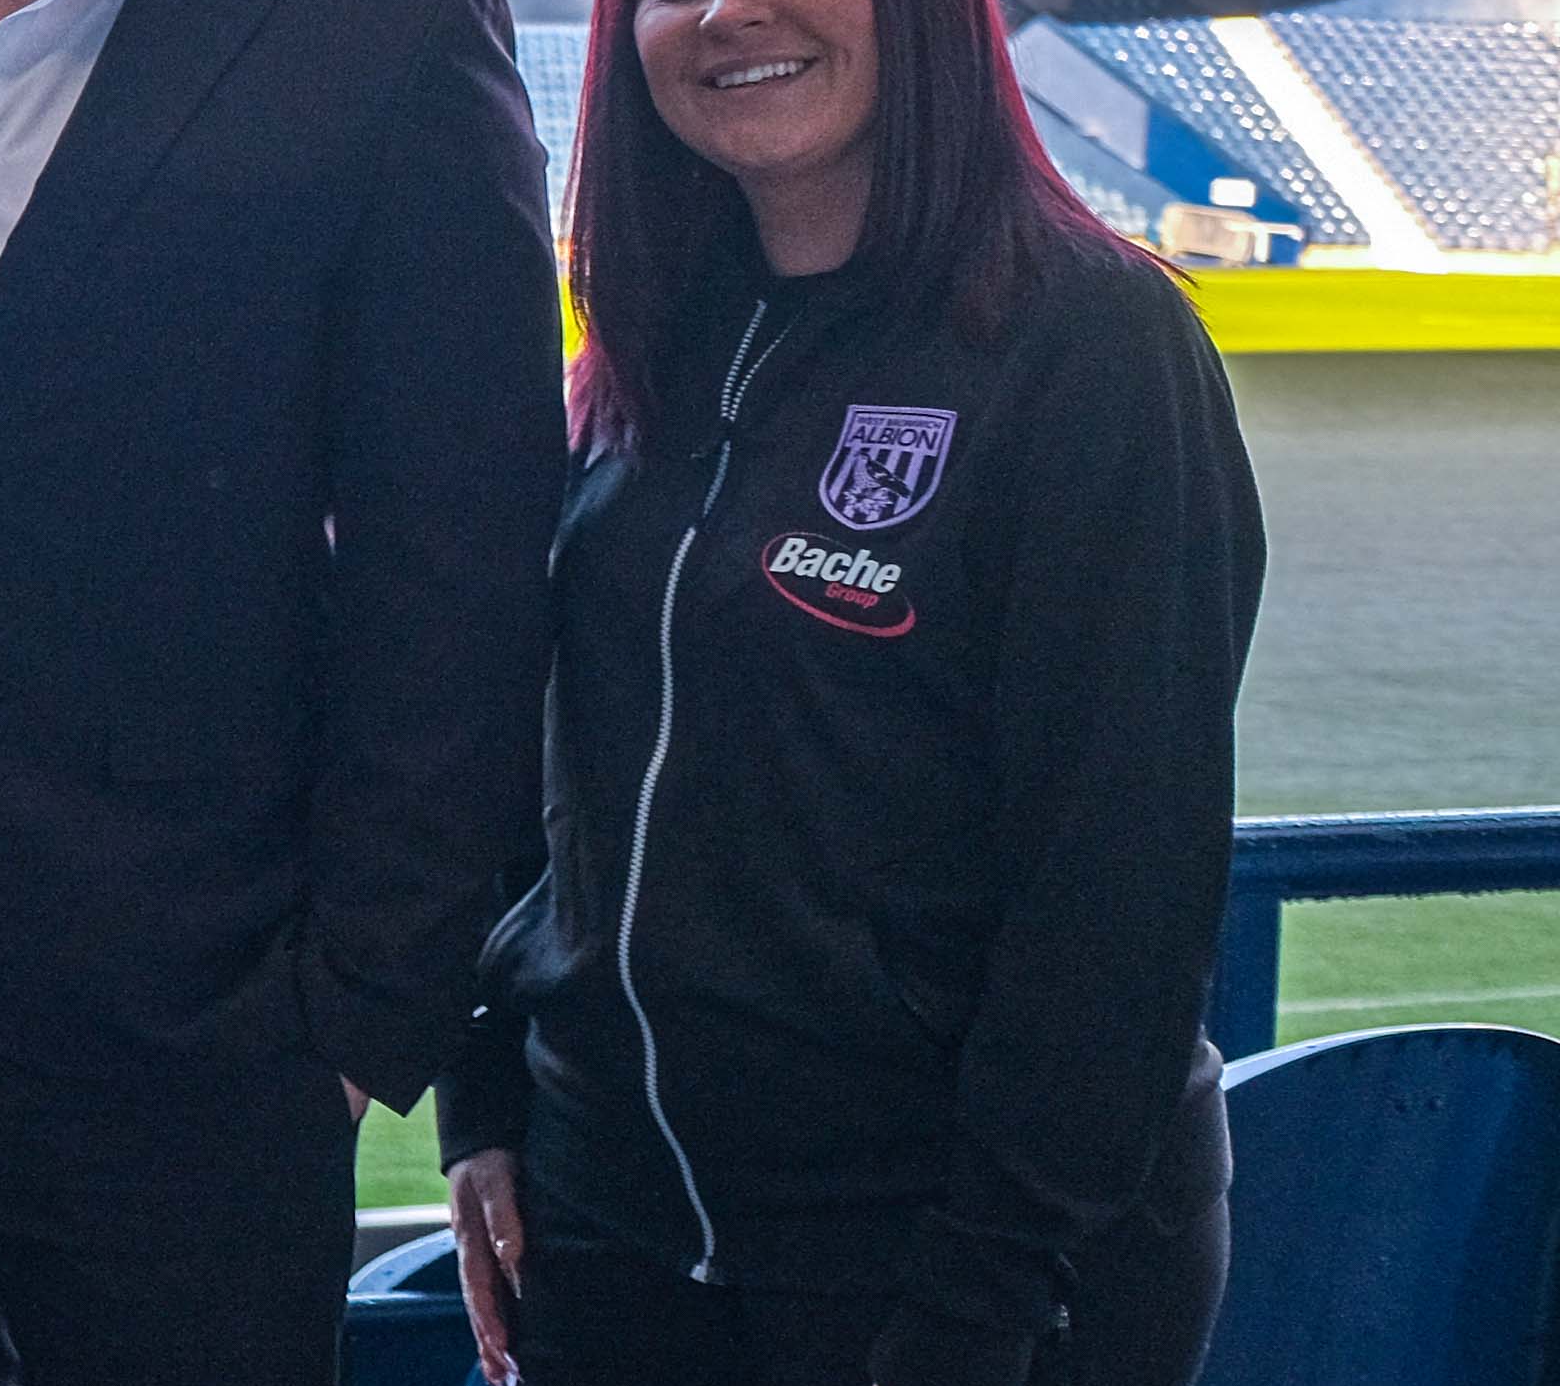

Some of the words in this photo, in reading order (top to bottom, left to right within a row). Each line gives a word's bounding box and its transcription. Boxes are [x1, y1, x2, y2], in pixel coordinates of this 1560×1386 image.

[849, 424, 940, 451] ALBION
[769, 537, 902, 593] Bache
[825, 581, 880, 609] Group
